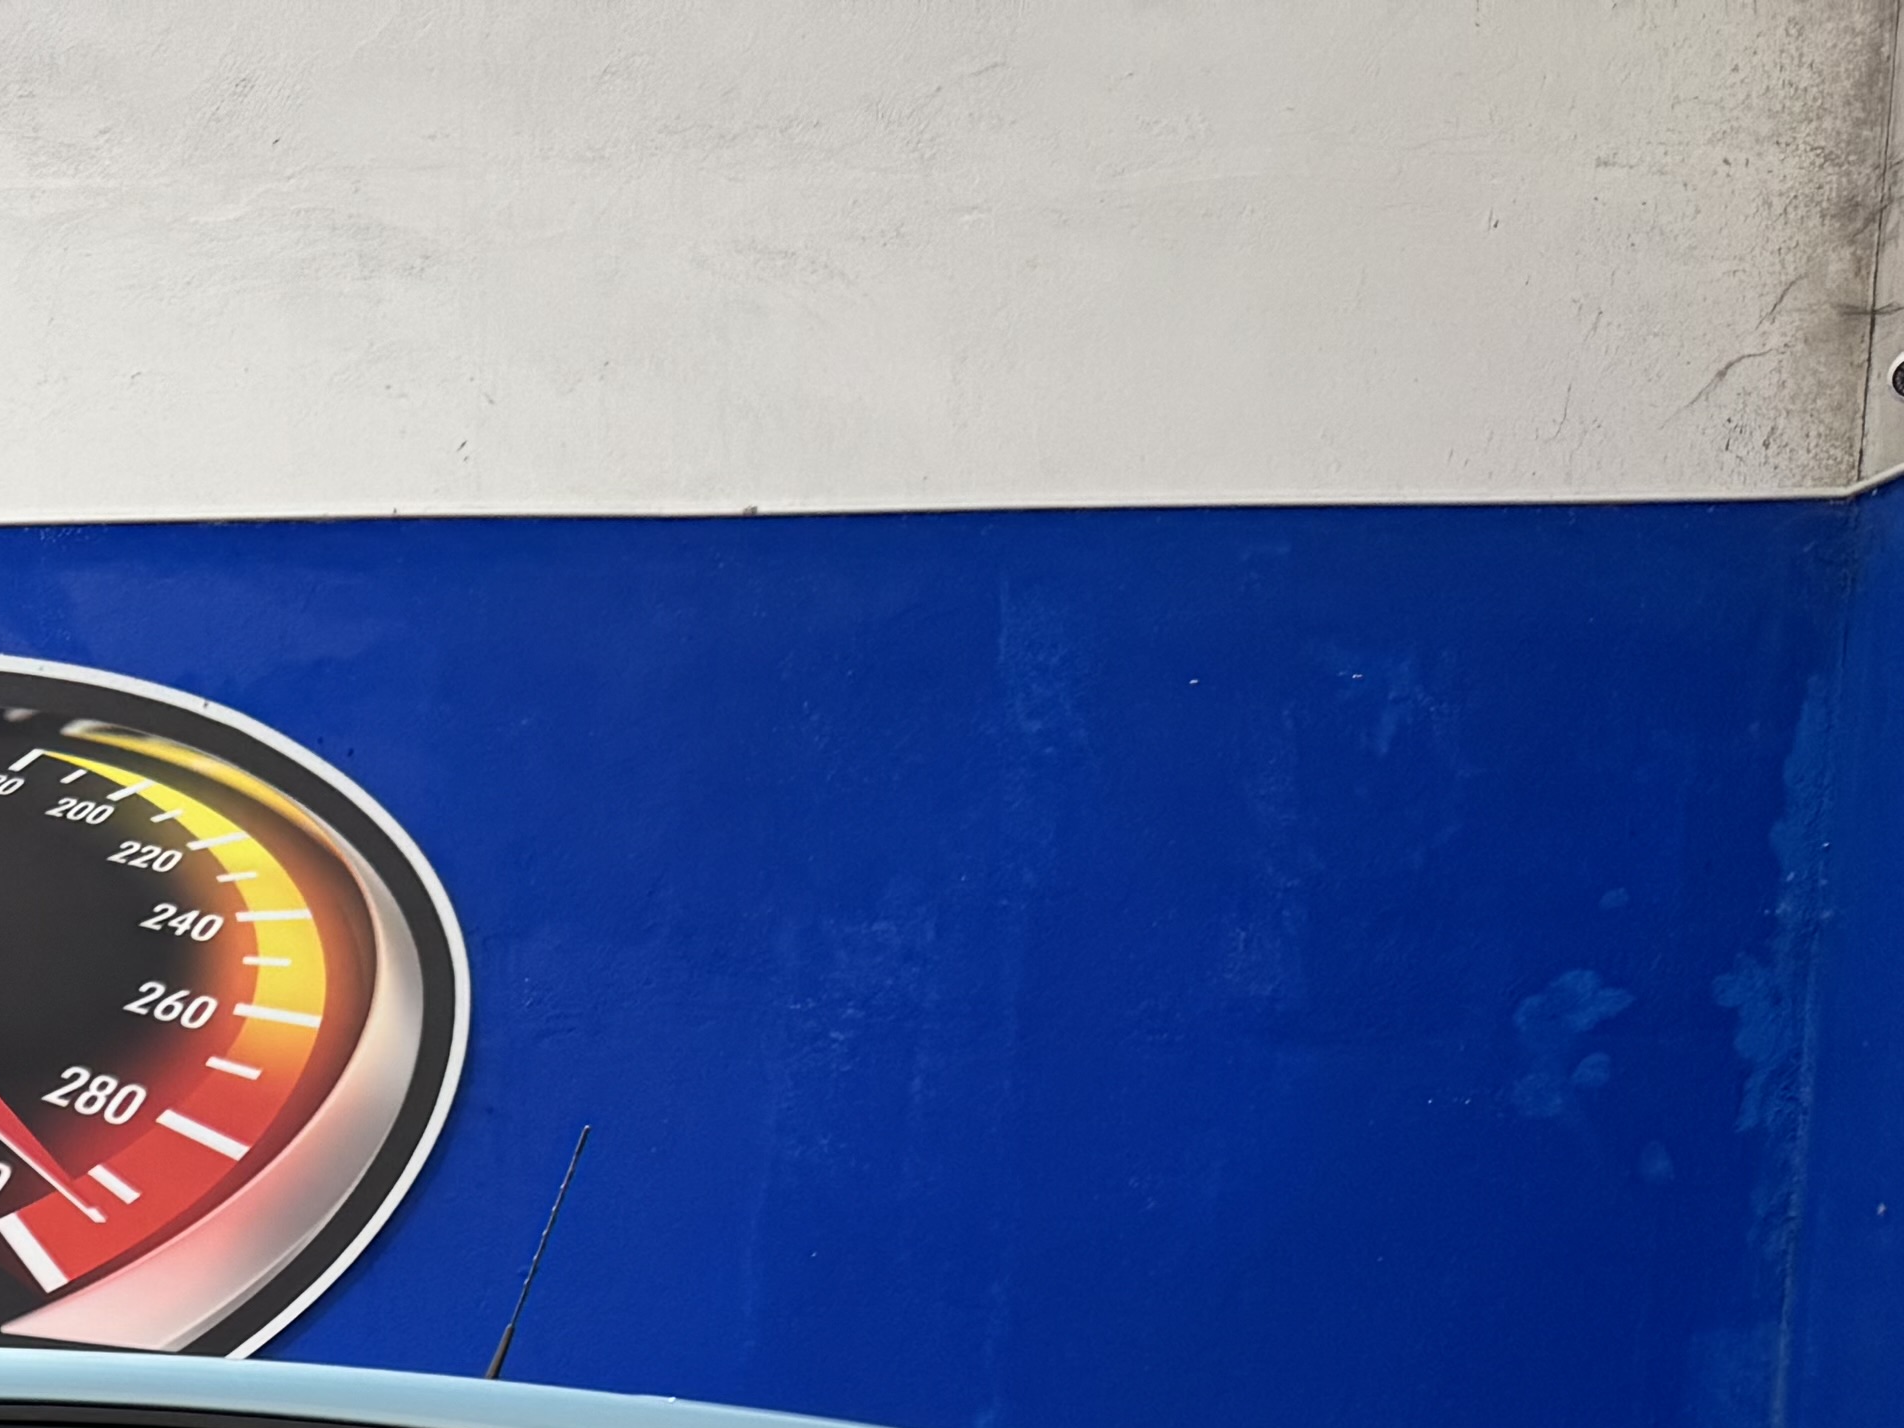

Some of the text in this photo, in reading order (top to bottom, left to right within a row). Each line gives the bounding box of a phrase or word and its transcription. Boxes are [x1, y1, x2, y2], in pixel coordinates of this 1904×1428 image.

[45, 797, 115, 825] 200
[106, 840, 183, 873] 220
[138, 902, 224, 942] 240
[122, 980, 218, 1029] 260
[41, 1066, 147, 1126] 280
